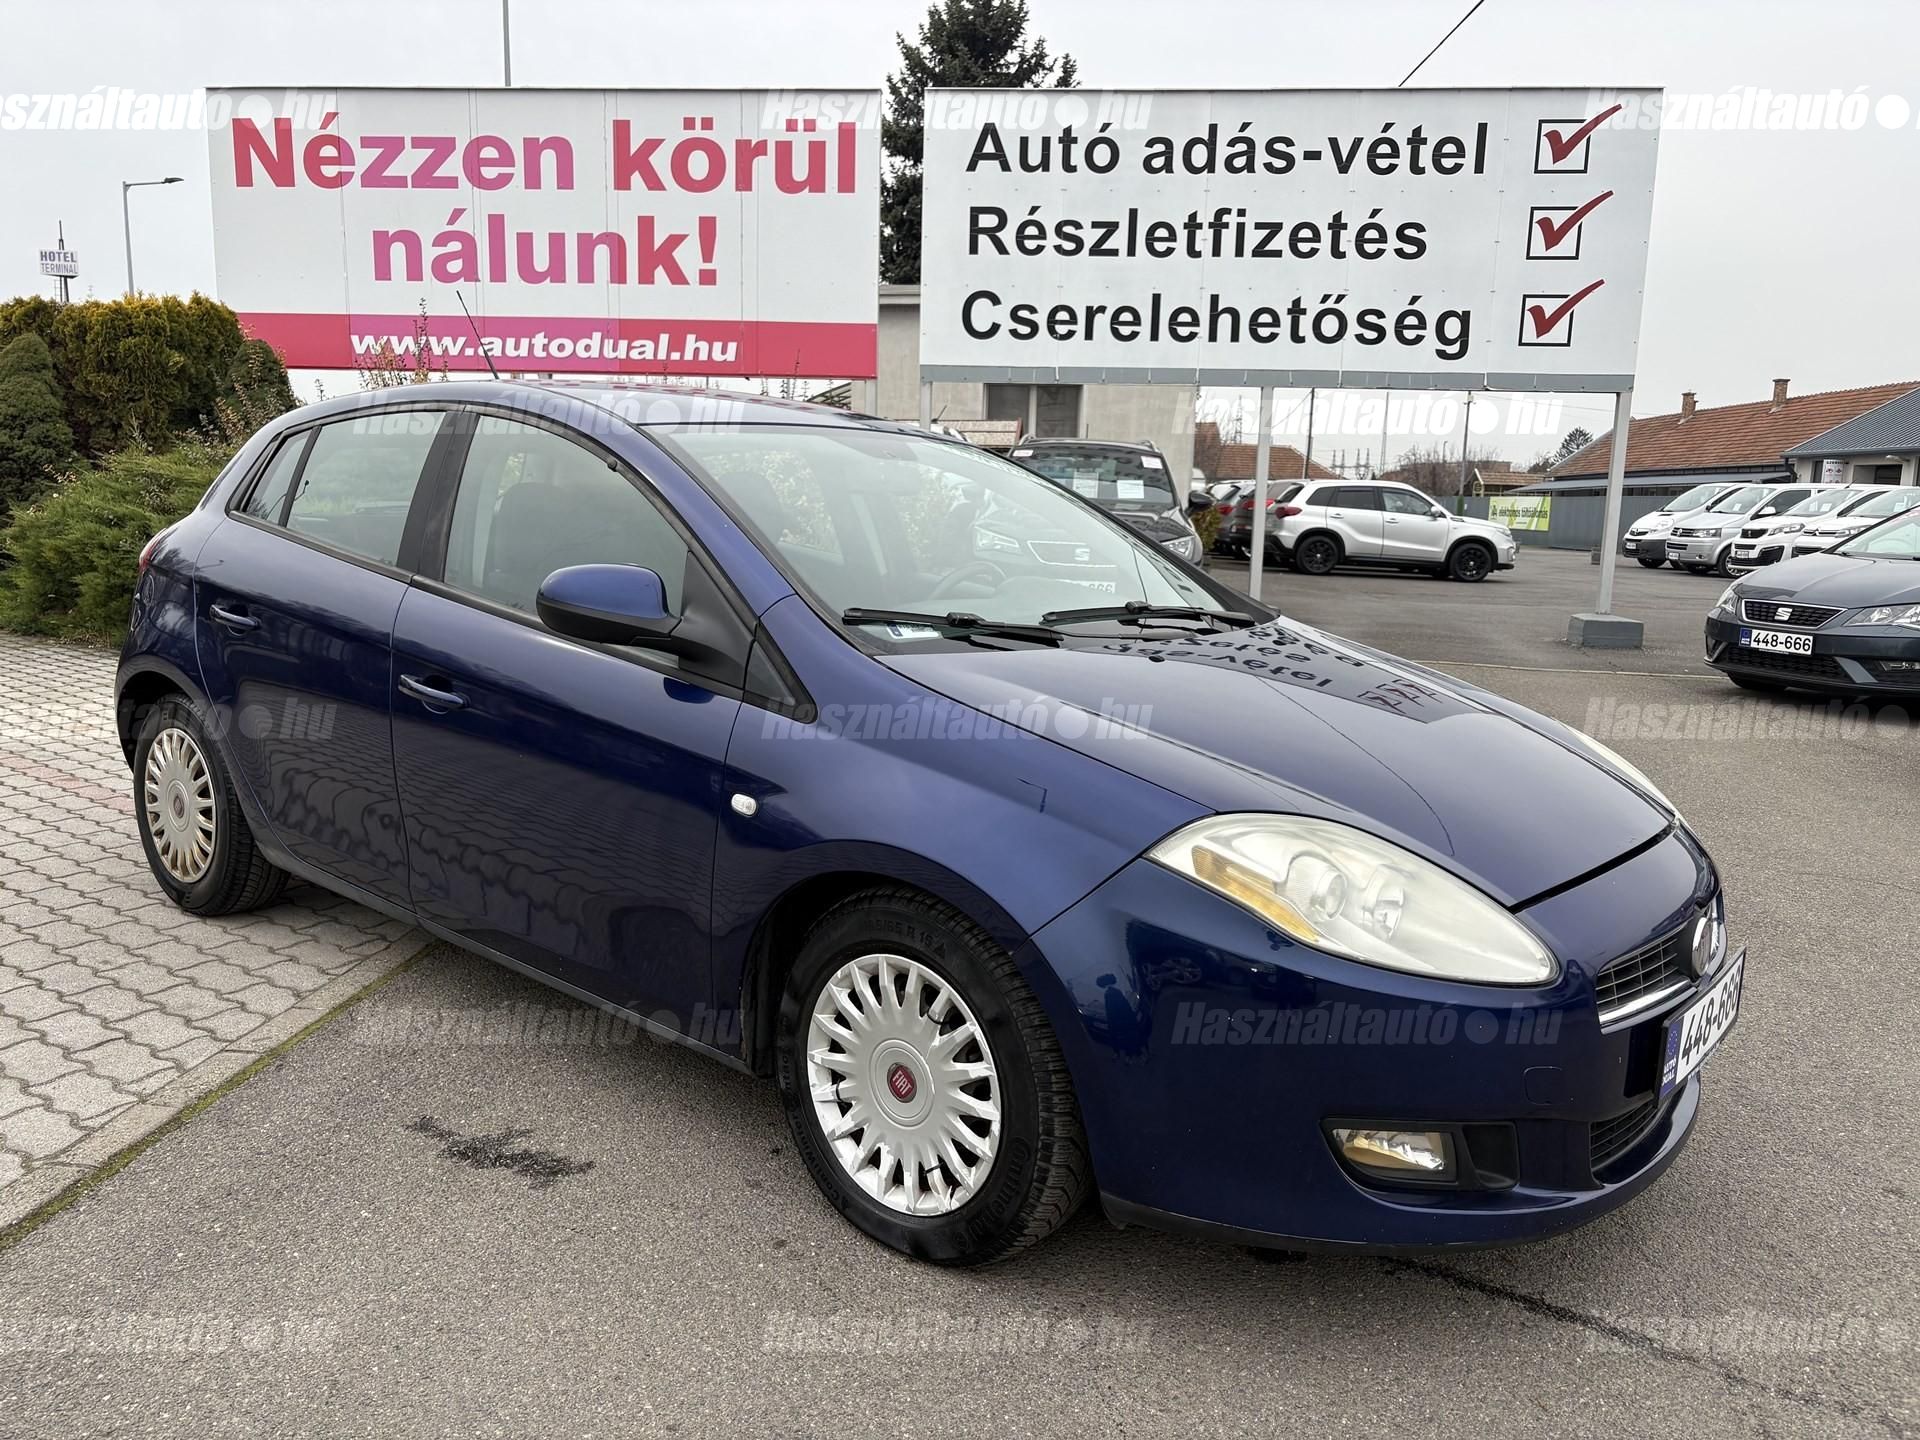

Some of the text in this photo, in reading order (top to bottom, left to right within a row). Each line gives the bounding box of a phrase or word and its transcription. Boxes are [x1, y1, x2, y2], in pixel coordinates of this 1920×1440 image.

[231, 111, 857, 194] Nézzen körül
[965, 121, 1489, 175] Autó adás-vétel
[40, 251, 77, 263] HOTEL
[372, 207, 718, 286] nálunk!
[968, 205, 1427, 260] Részletfizetés
[40, 263, 78, 274] TERMINAL
[350, 331, 738, 362] www.autodual.hu
[961, 289, 1472, 361] Cserelehetőség
[1753, 632, 1812, 652] 448-666
[1681, 965, 1742, 1066] 448-666
[892, 1070, 913, 1095] FIAT
